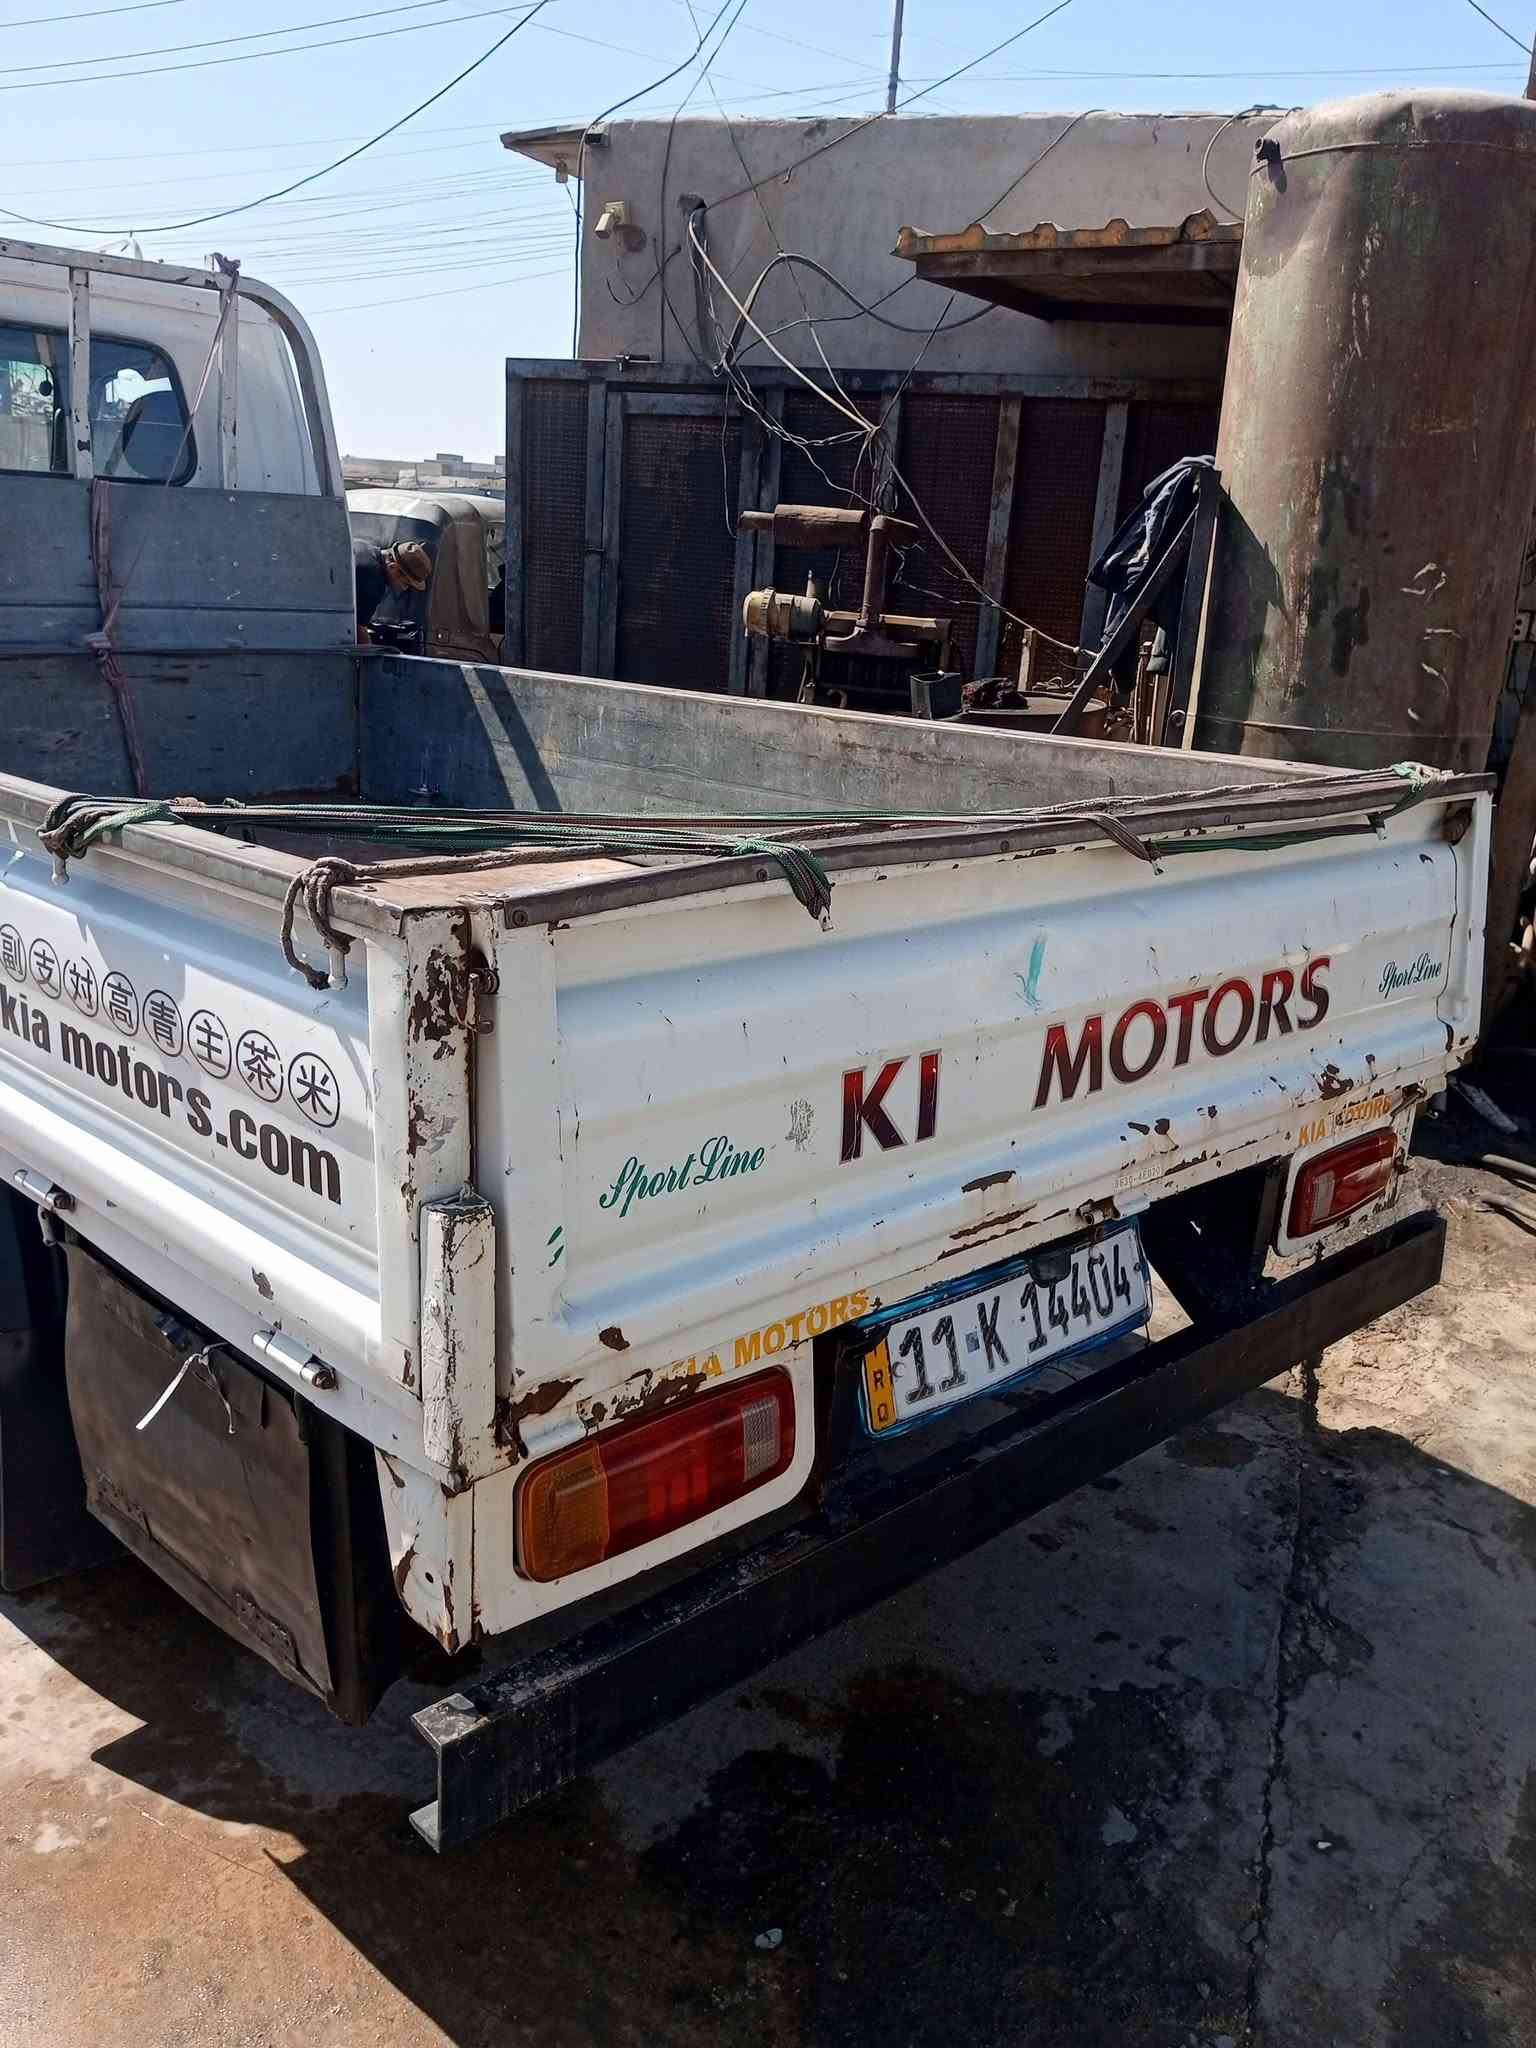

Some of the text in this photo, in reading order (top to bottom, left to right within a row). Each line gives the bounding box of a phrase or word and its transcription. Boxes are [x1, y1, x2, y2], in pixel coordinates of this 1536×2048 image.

[1378, 952, 1442, 999] Sport Line
[0, 982, 342, 1206] kia motors.com
[838, 955, 1331, 1165] KI MOTORS
[599, 1135, 765, 1218] Sport Line
[734, 1289, 869, 1368] MOTORS
